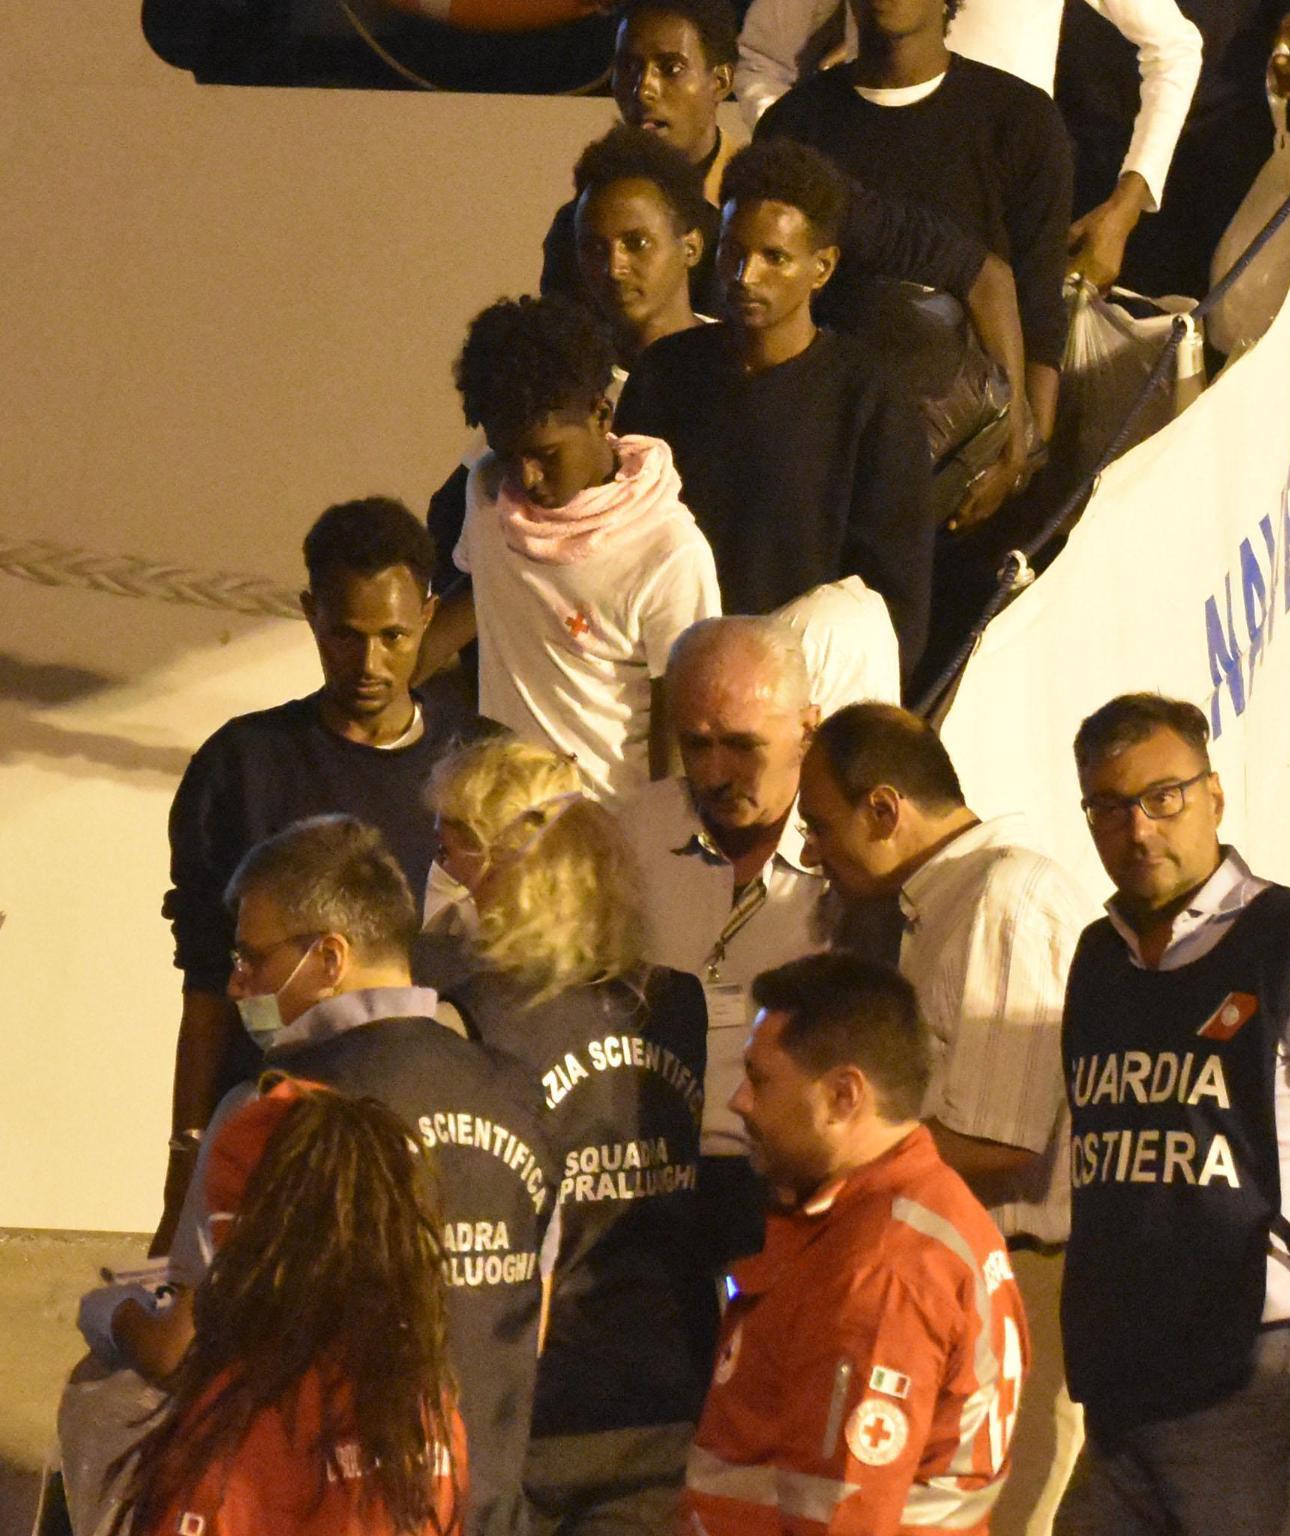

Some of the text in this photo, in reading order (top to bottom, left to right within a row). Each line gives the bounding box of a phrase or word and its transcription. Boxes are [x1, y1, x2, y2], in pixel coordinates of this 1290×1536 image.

[541, 1035, 703, 1126] ZIA SCIENTIFIC
[1071, 1050, 1231, 1110] UARDIA
